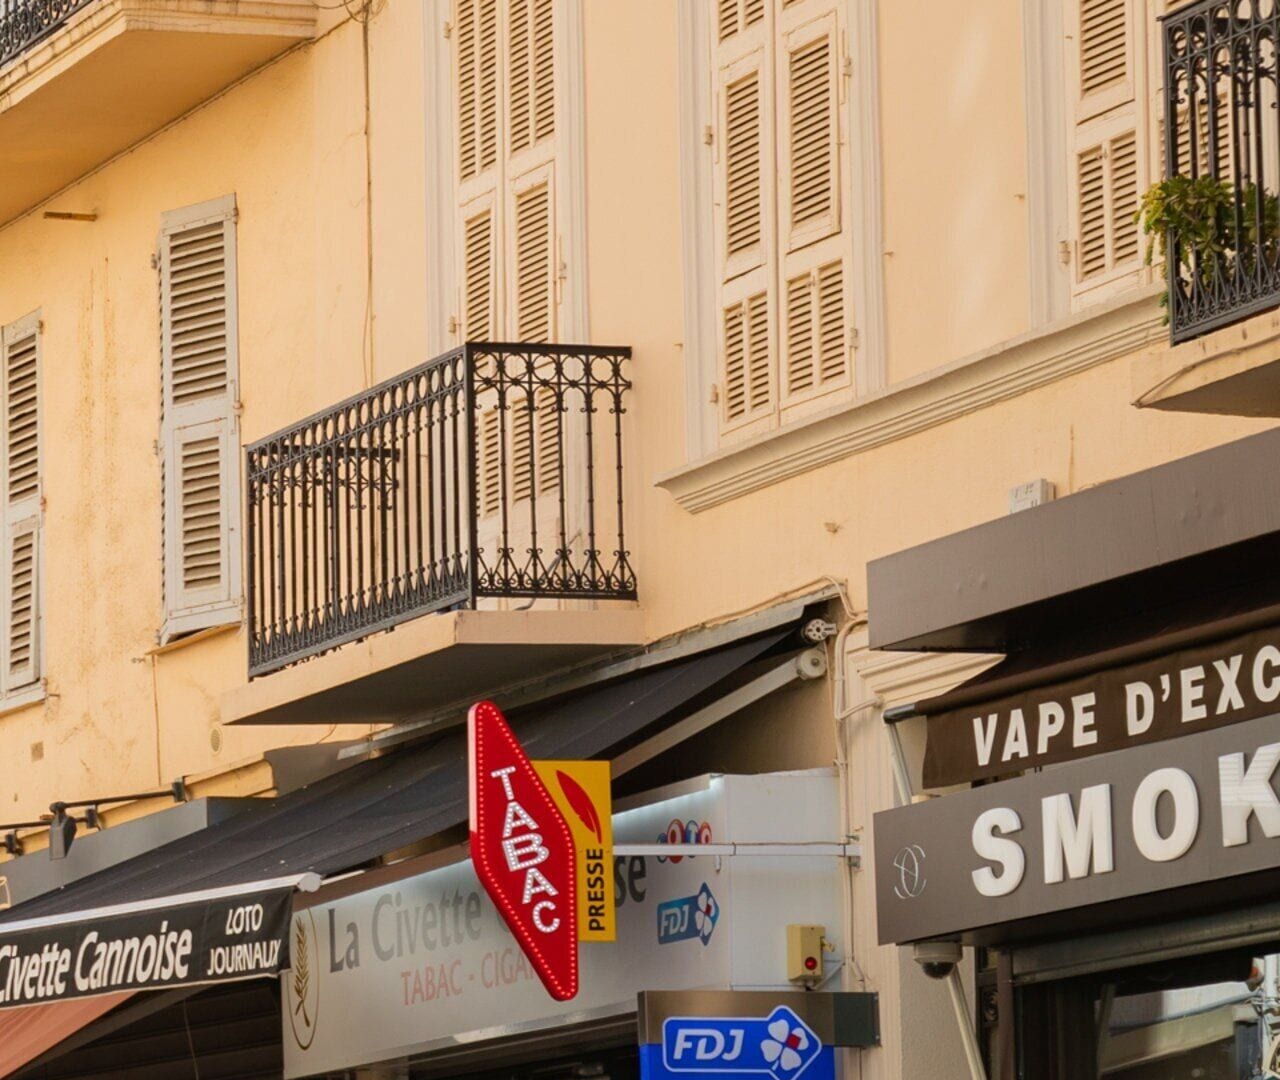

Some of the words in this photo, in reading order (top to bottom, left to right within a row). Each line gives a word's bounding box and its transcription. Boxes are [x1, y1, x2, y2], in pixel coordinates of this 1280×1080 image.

[973, 692, 1098, 767] VAPE
[491, 765, 560, 933] TABAC
[971, 742, 1280, 898] SMOK
[225, 903, 264, 936] LOTO
[589, 848, 605, 931] PRESSE
[660, 903, 690, 938] FDJ
[75, 920, 193, 992] Cannoise
[207, 938, 282, 976] JOURNAUX
[328, 907, 360, 973] La
[370, 886, 482, 962] Civette
[400, 960, 463, 1006] TABAC
[673, 1028, 745, 1062] FDJ
